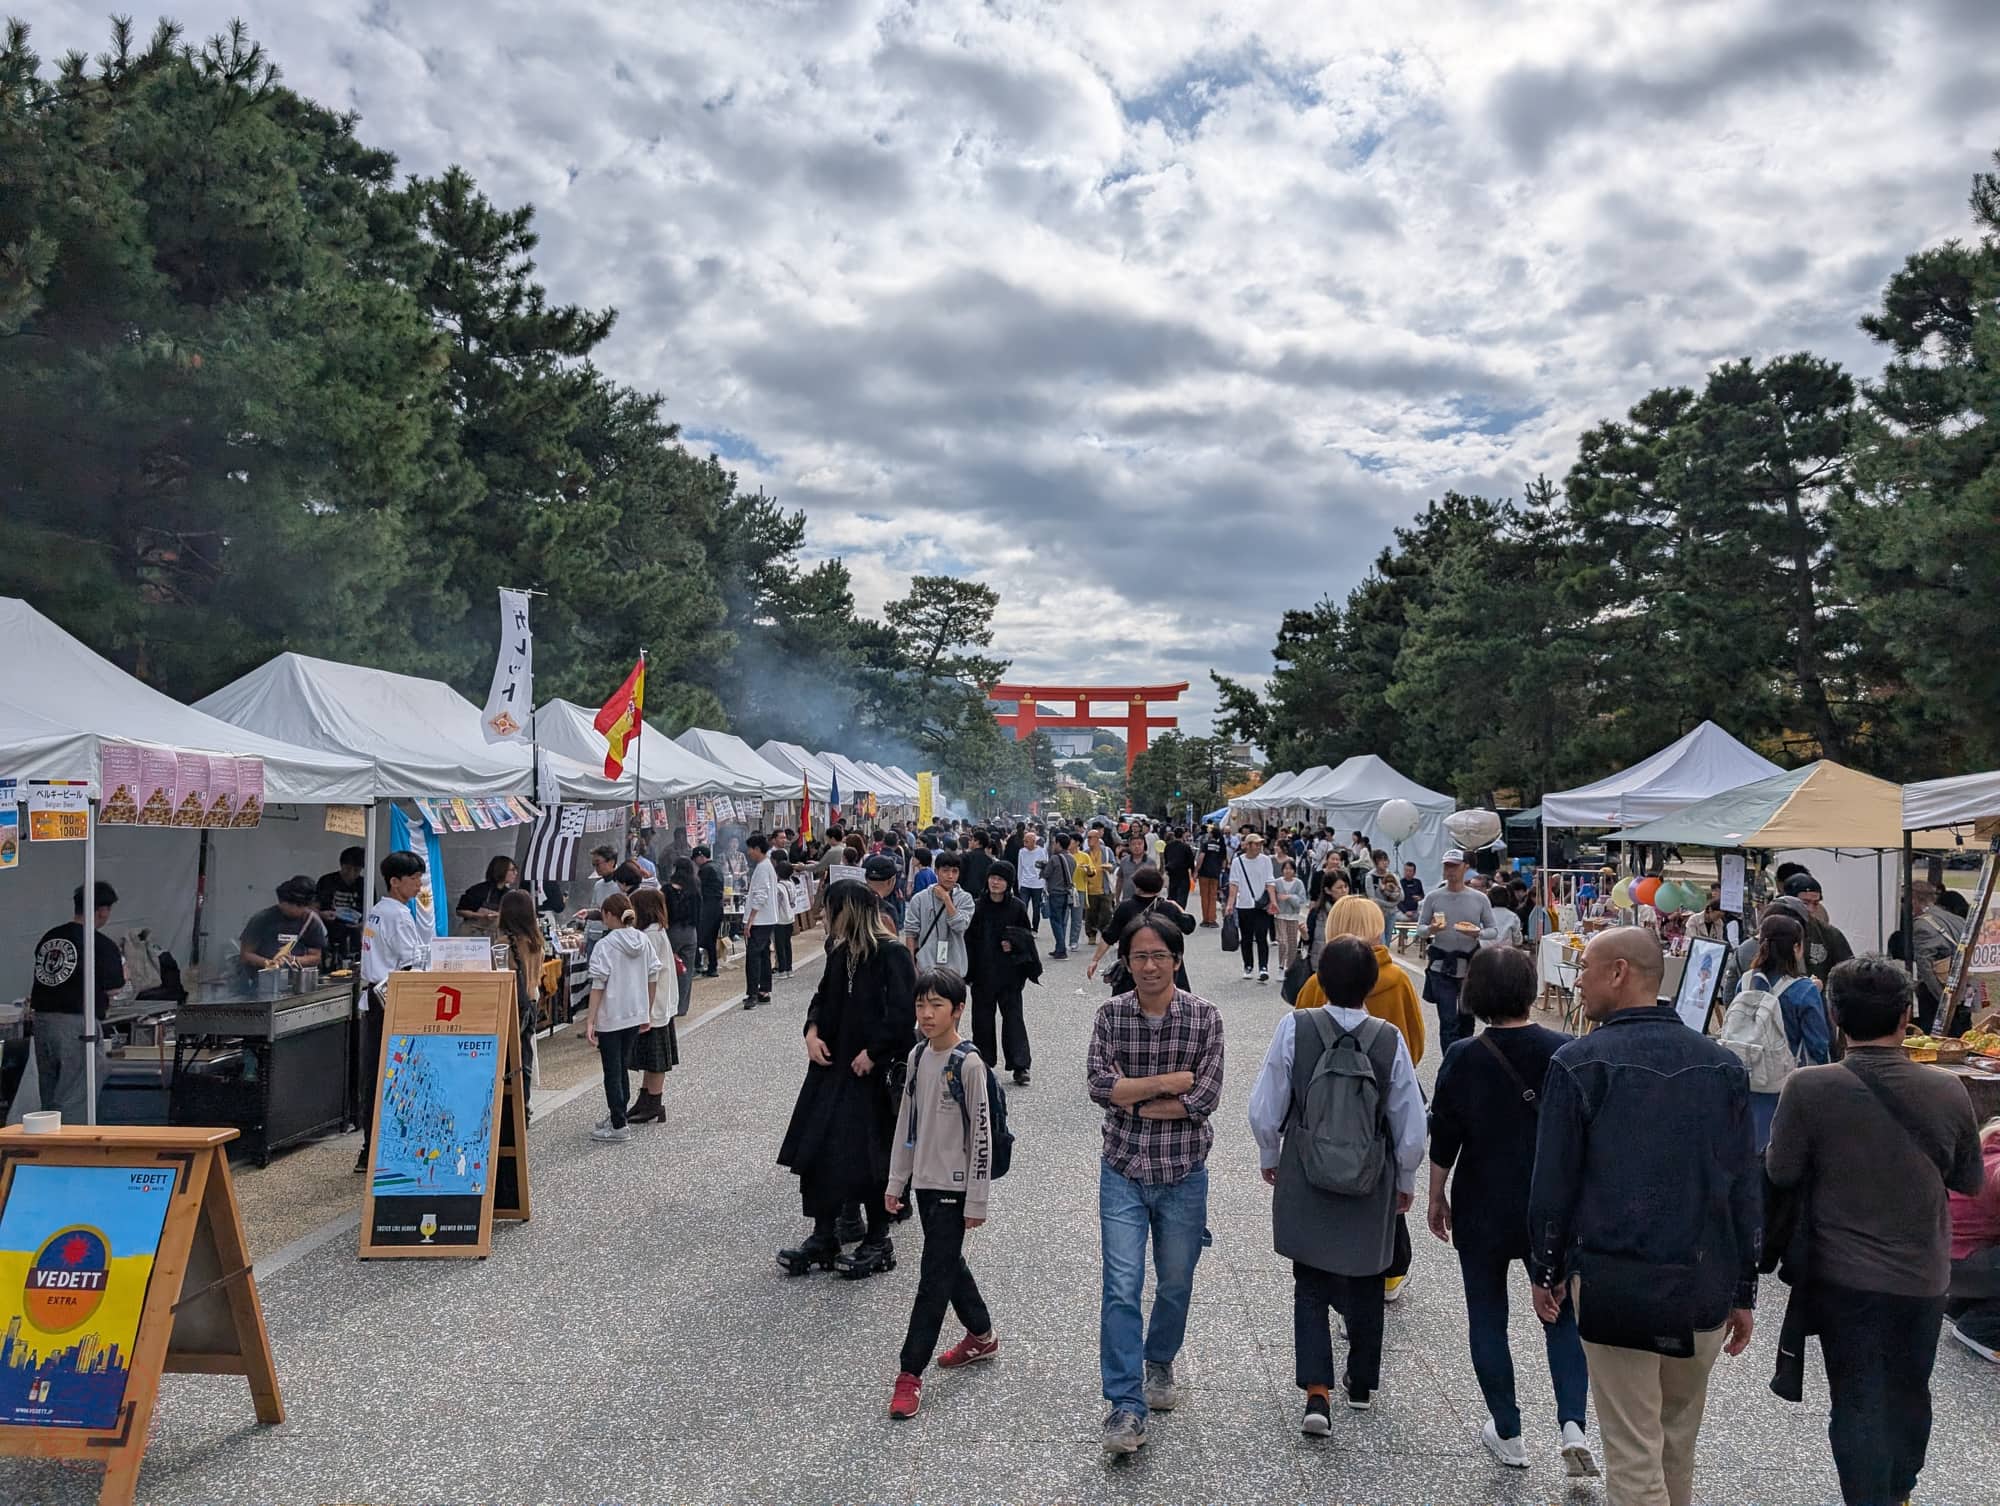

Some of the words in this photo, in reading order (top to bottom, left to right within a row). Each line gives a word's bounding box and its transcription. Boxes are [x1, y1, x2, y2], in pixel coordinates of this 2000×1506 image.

[457, 1041, 492, 1050] VEDETT
[976, 1102, 989, 1180] RAPTURE
[130, 1174, 168, 1184] VEDETT
[37, 1271, 102, 1288] VEDETT
[47, 1296, 77, 1305] EXTRA
